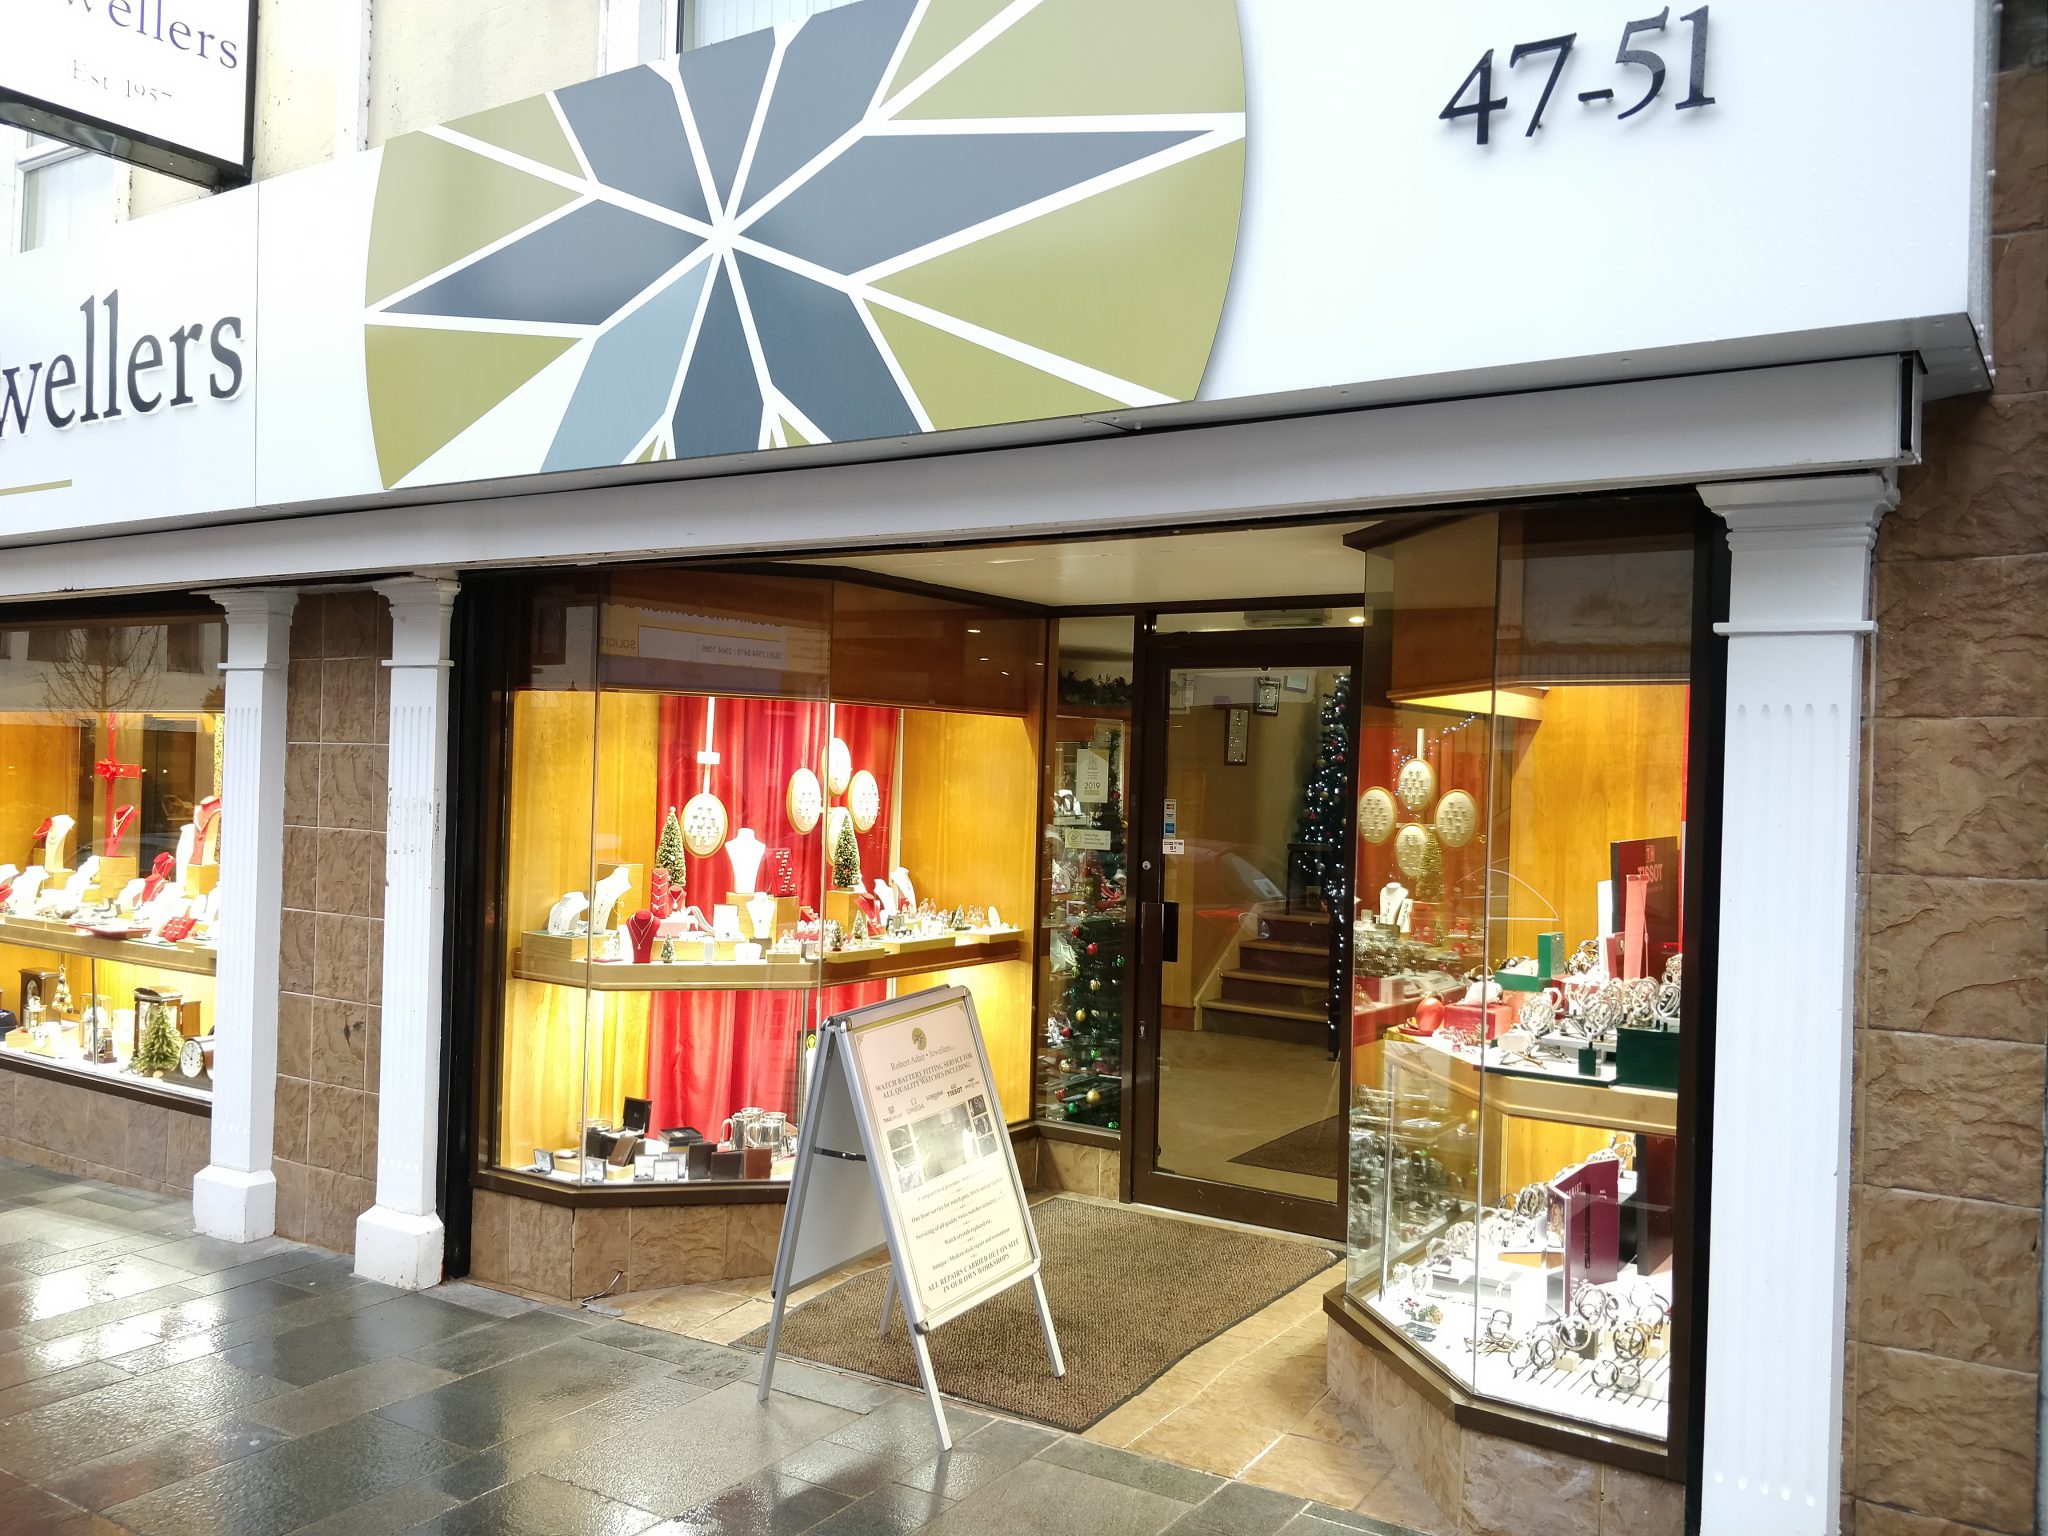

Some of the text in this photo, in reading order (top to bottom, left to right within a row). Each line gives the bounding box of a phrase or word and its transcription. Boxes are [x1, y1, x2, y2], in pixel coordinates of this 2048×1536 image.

[1438, 5, 1716, 145] 47-51
[1084, 782, 1100, 790] 2019
[875, 1080, 897, 1092] WATCH
[898, 1071, 922, 1084] BATTERY
[923, 1064, 943, 1075] FITTING
[944, 1056, 964, 1067] SERVICE
[883, 1090, 895, 1099] ALL
[895, 1081, 920, 1095] QUALITY
[920, 1072, 944, 1085] WATCHES
[947, 1087, 963, 1097] TISSOT
[928, 1239, 1019, 1292] ALL REPAIRS CARRIED OUT ON SITE
[950, 1278, 963, 1289] OUR
[963, 1271, 977, 1282] OWN
[977, 1253, 1010, 1274] WORKSHOPS
